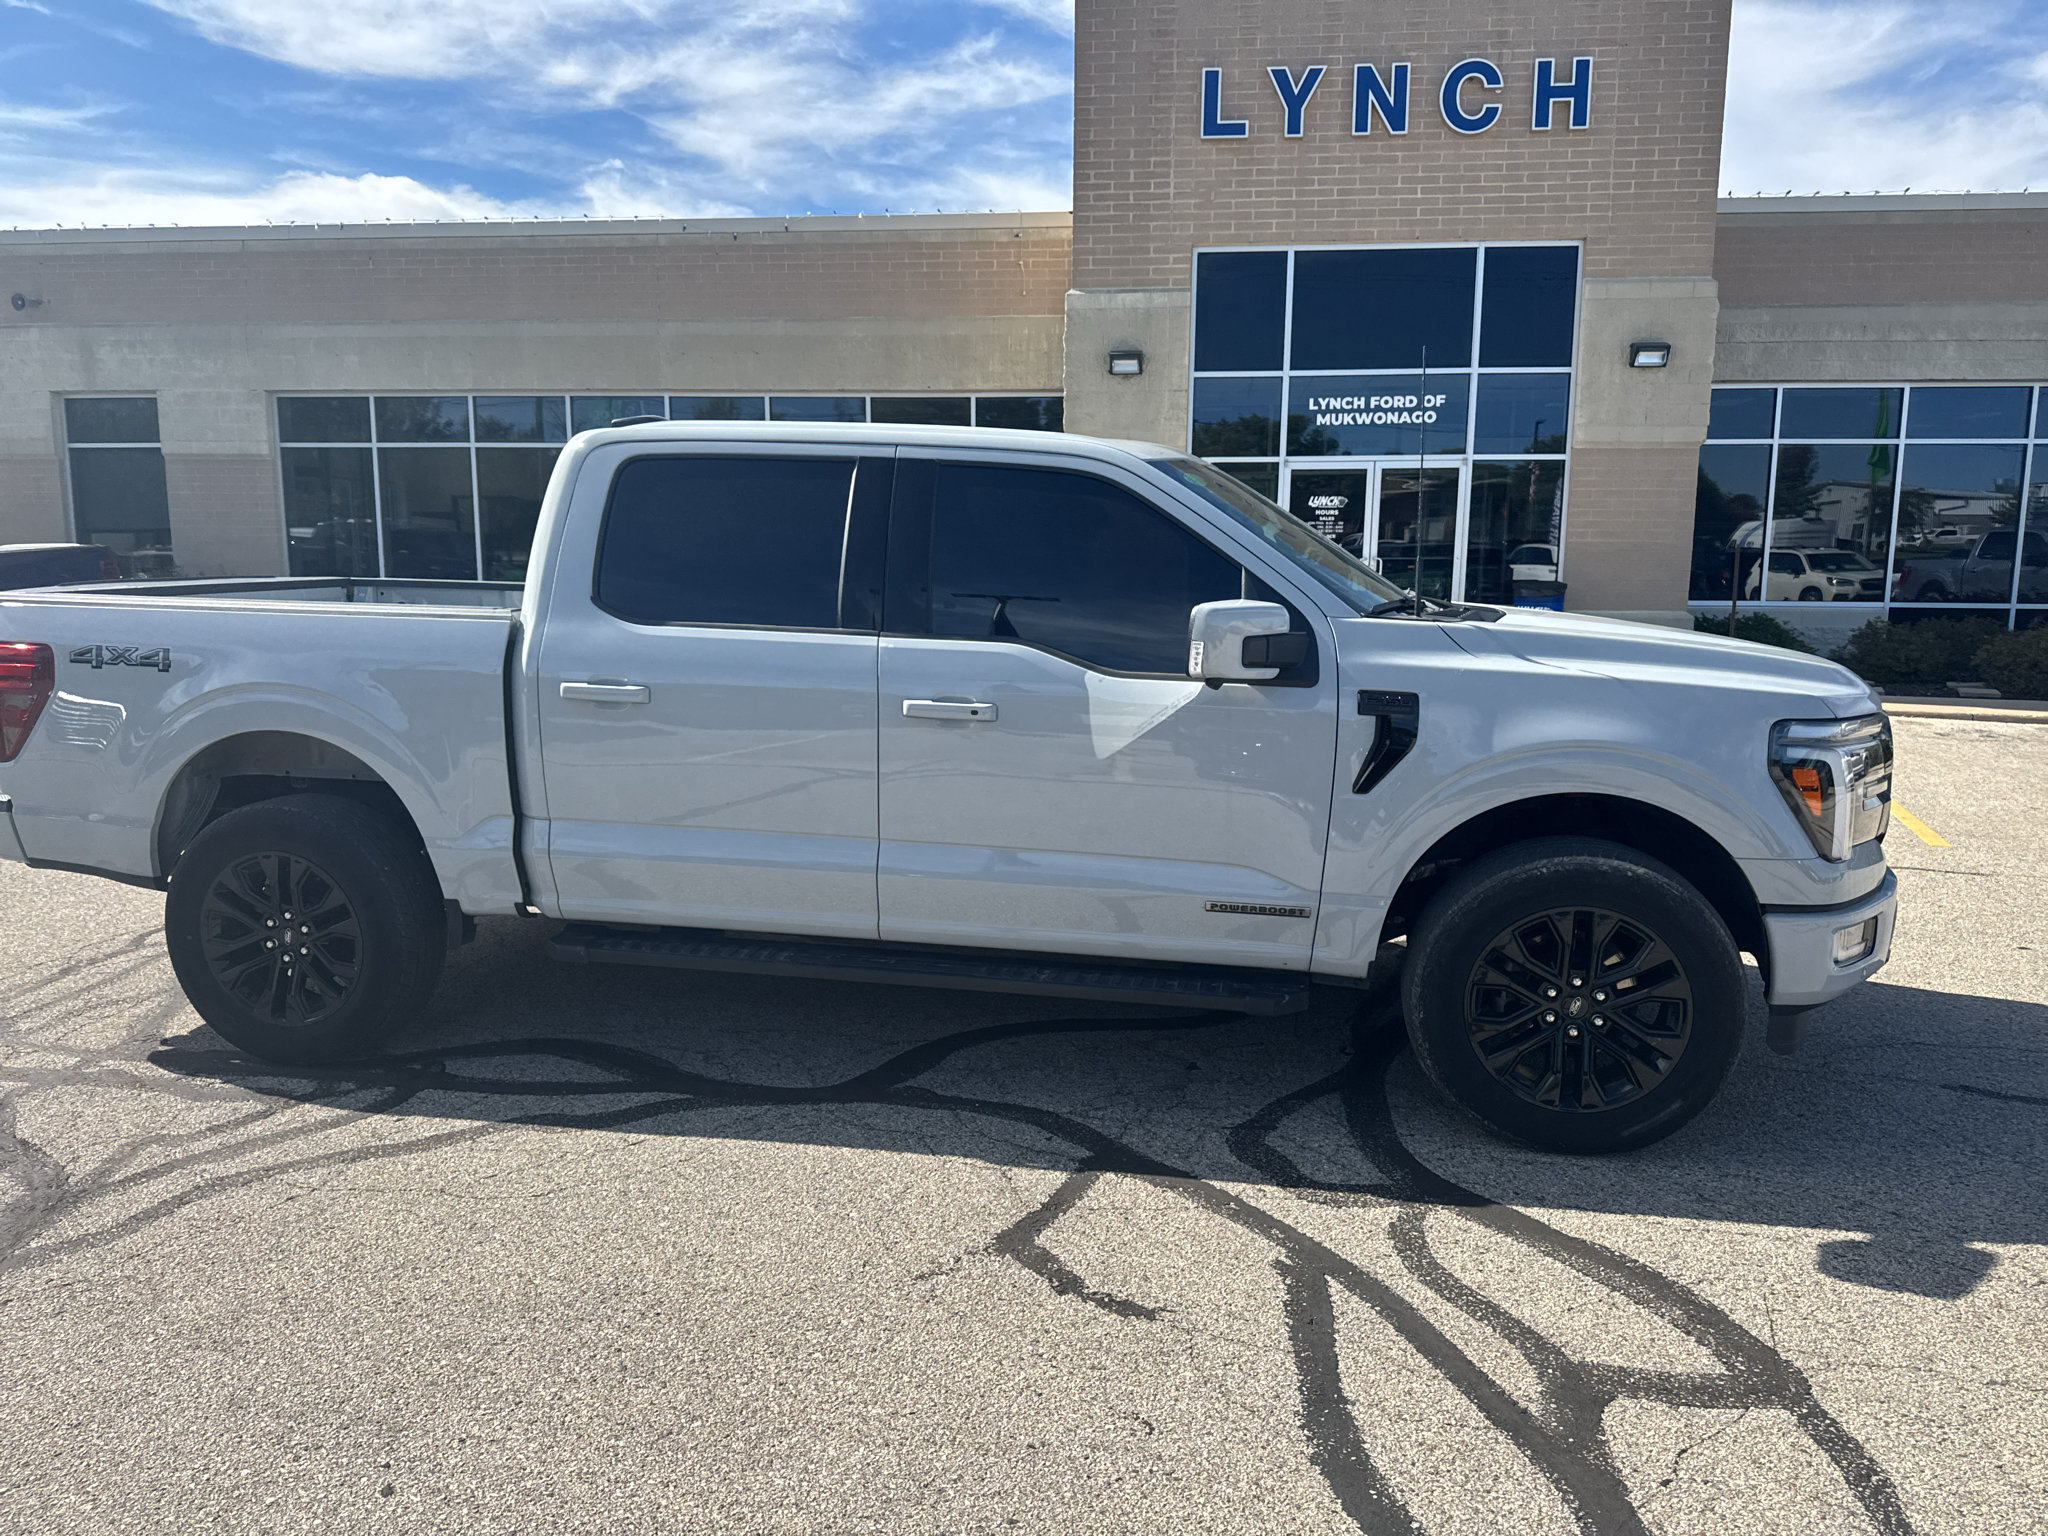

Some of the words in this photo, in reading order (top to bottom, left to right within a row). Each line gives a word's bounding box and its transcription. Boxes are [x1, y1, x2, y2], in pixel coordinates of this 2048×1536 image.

[1201, 56, 1594, 139] LYNCH
[1308, 396, 1366, 410] LYNCH
[1369, 395, 1418, 409] FORD
[1423, 394, 1447, 408] OF
[1316, 410, 1437, 426] MUKWONAGO
[1308, 495, 1339, 508] LYNCH
[1210, 903, 1306, 916] POWERBOOST
